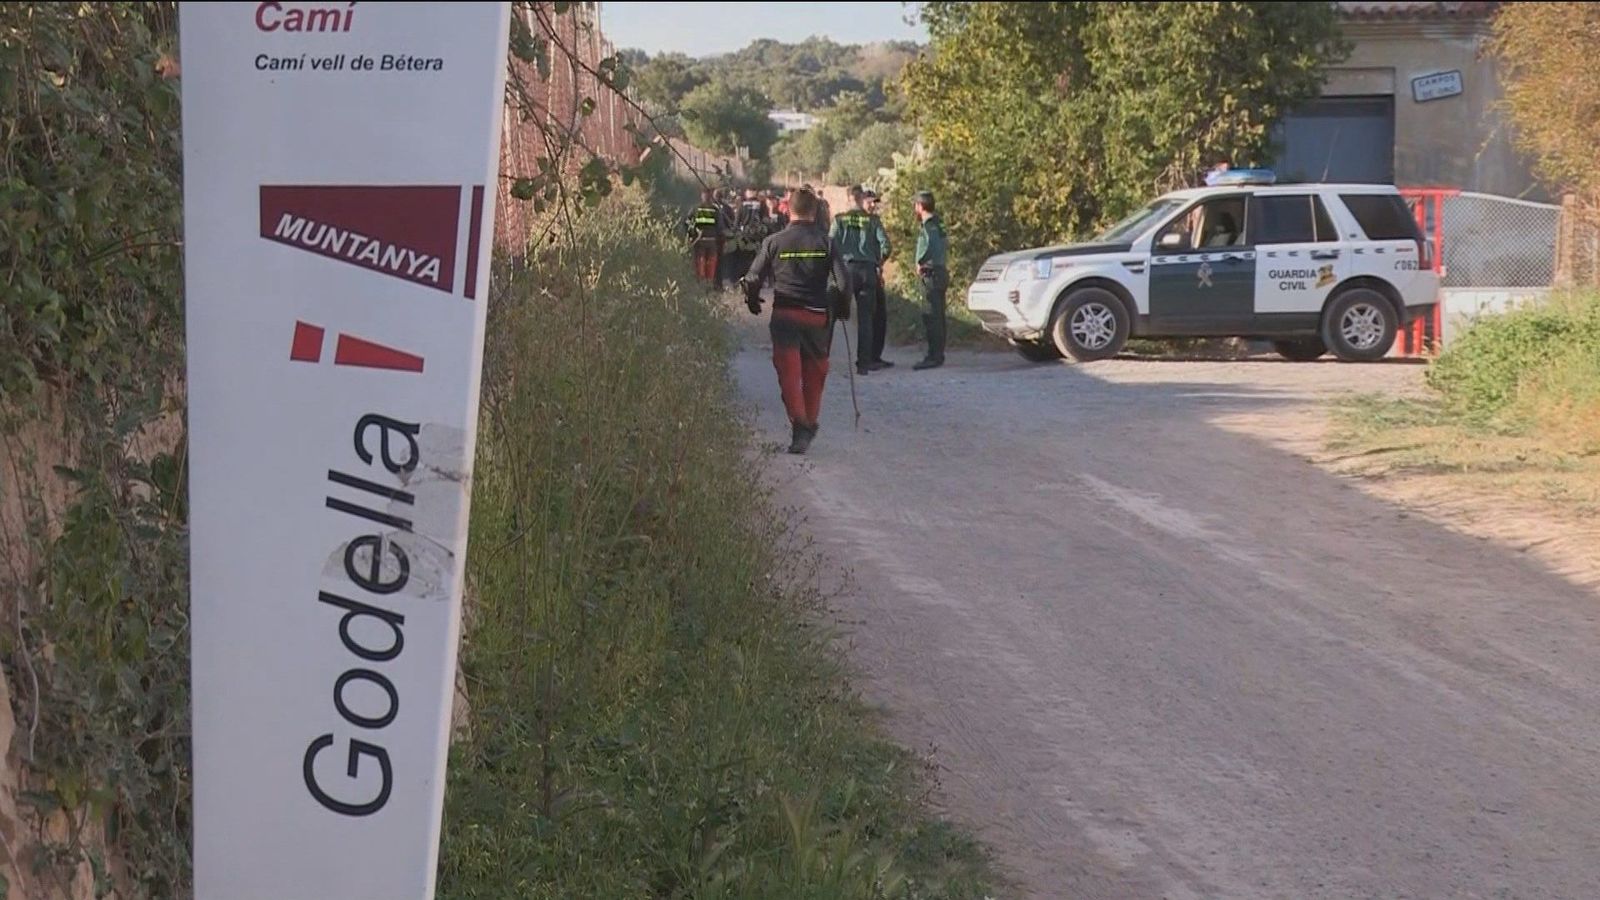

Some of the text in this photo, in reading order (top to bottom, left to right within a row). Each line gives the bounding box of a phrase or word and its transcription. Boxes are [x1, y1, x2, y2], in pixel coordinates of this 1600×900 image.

[255, 2, 353, 32] Camí
[255, 53, 444, 71] Camí vell de Bétera
[274, 213, 442, 283] MUNTANYA
[1268, 269, 1317, 279] GUARDIA
[1279, 281, 1308, 291] CIVIL
[303, 412, 421, 818] Godella
